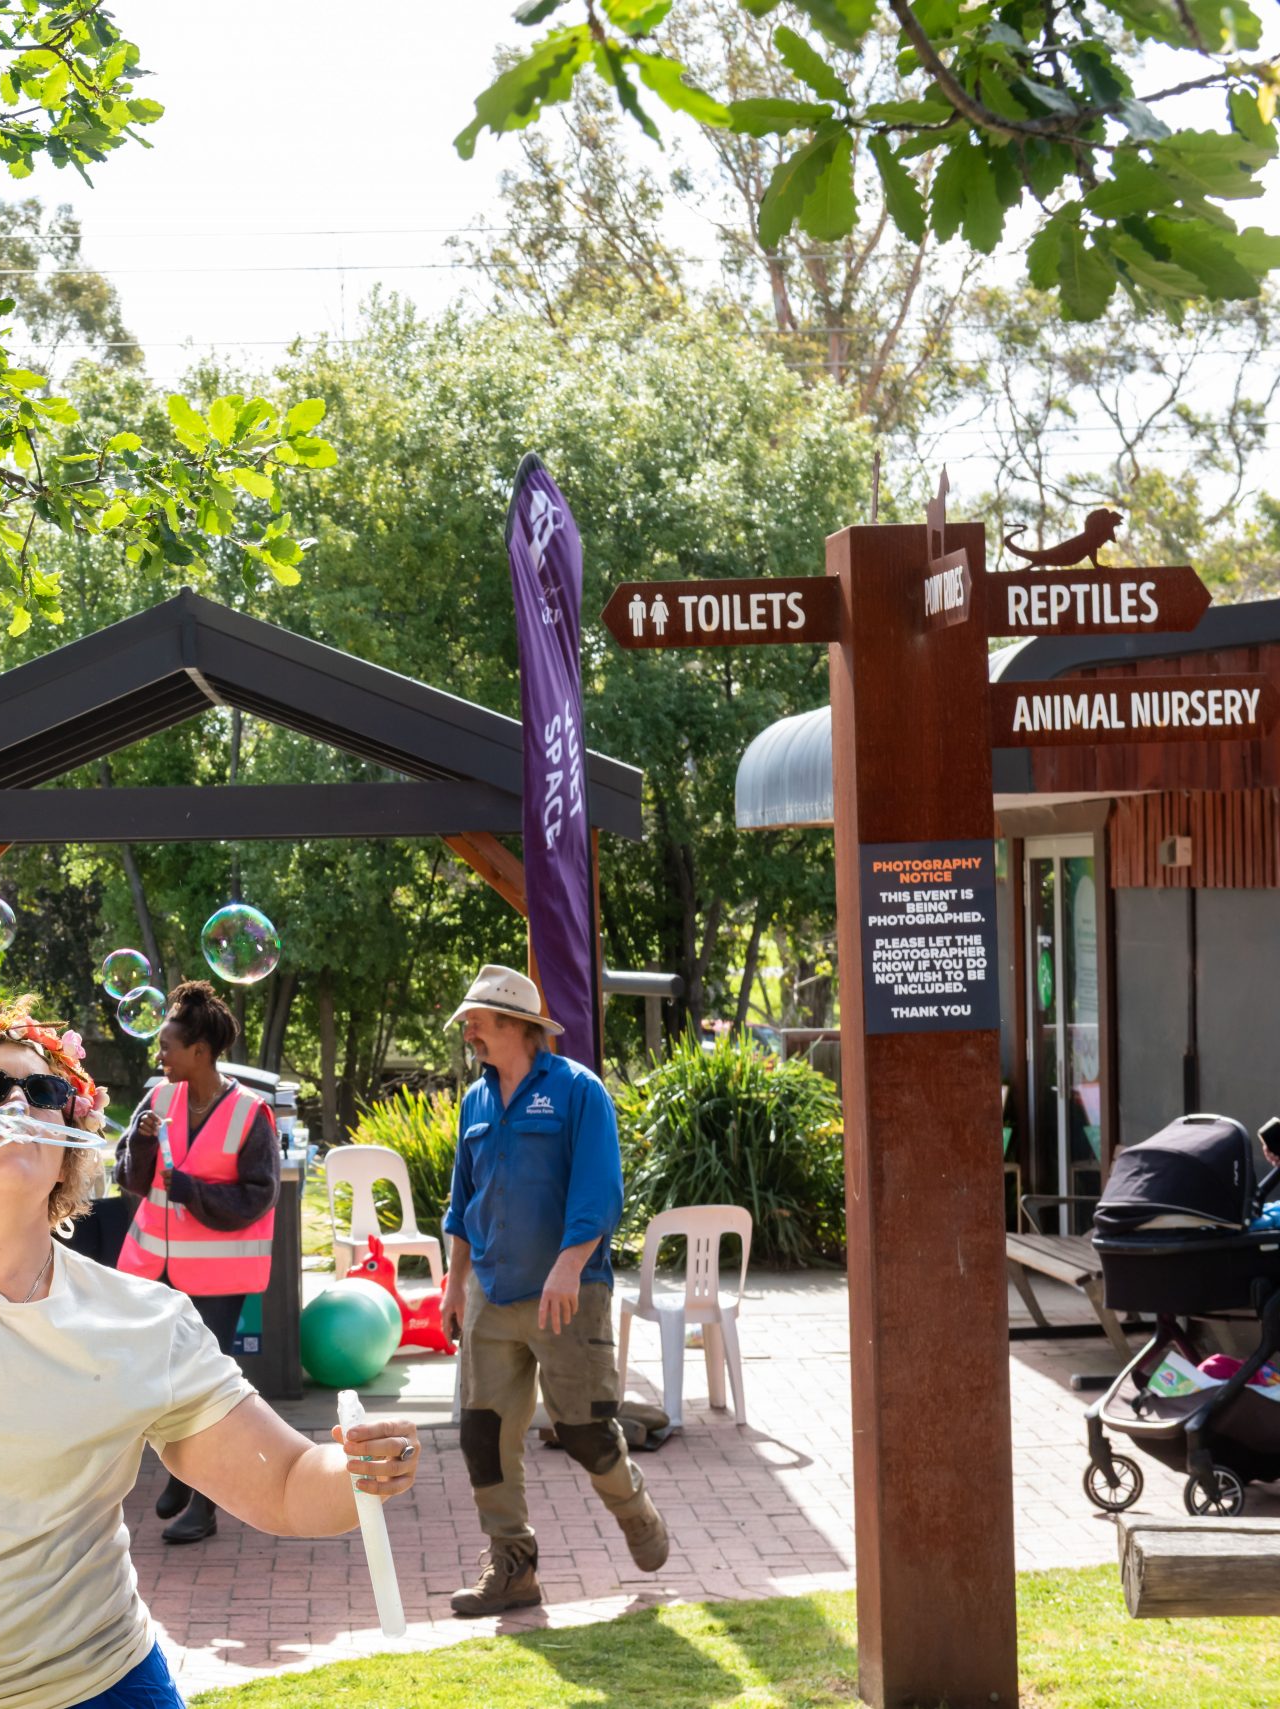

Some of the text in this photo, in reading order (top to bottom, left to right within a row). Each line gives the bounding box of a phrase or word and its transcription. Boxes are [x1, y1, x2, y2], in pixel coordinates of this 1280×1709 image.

[1007, 581, 1159, 626] REPTILES
[678, 592, 806, 633] TOILETS
[1012, 688, 1260, 732] ANIMAL NURSERY
[544, 714, 564, 850] SPACE
[873, 858, 982, 873] PHOTOGRAPHY
[900, 871, 952, 884] NOTICE
[880, 889, 974, 903] THIS EVENT IS
[906, 901, 948, 913] BEING
[868, 912, 986, 926] PHOTOGRAPHED.
[875, 935, 982, 949] PLEASE LET THE
[873, 946, 986, 961] PHOTOGRAPHER
[872, 958, 987, 973] KNOW IF YOU DO
[875, 969, 985, 984] NOT WISH TO BE
[894, 982, 967, 995] INCLUDED.
[891, 1004, 971, 1018] THANK YOU
